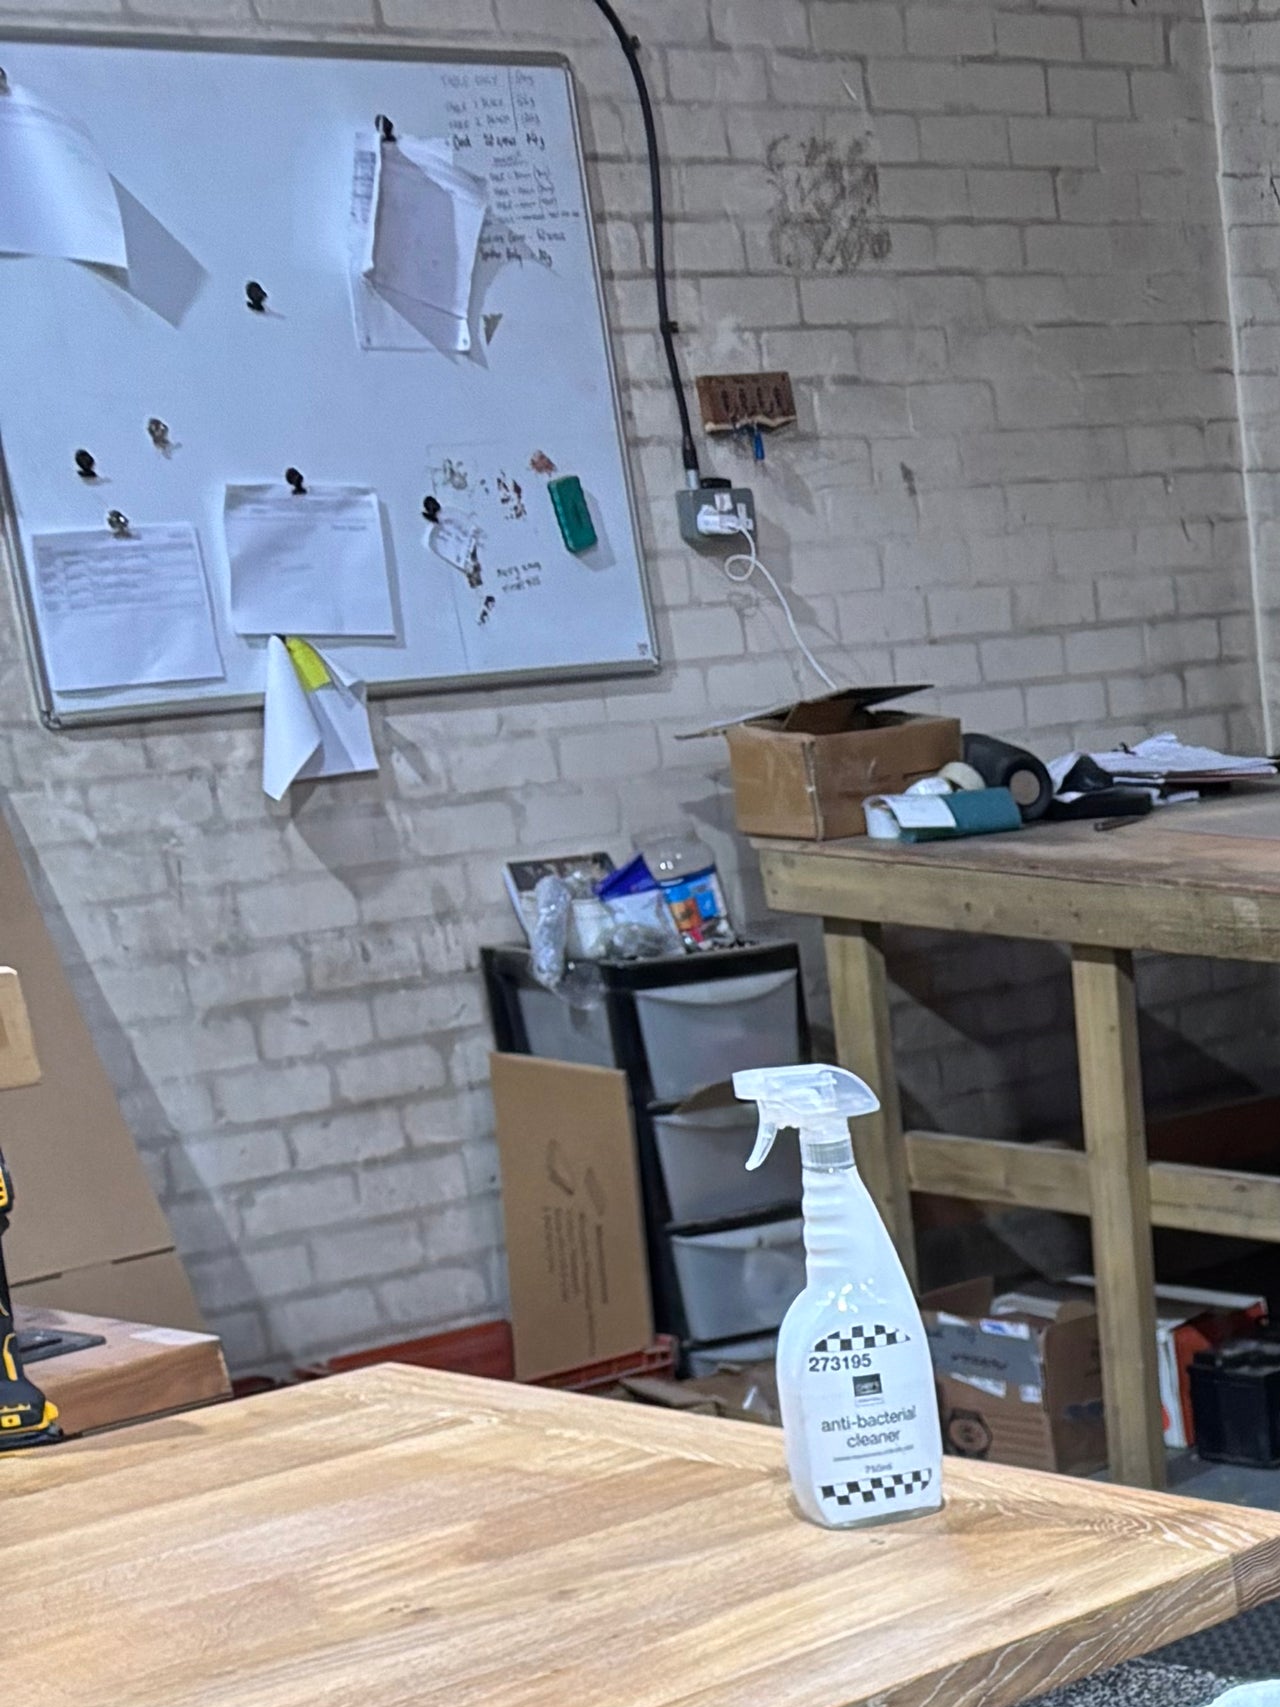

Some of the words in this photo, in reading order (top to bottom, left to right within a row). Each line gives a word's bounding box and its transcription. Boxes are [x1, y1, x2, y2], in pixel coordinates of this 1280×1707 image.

[808, 1353, 872, 1373] 273195
[821, 1405, 917, 1433] anti-bacterial
[846, 1430, 901, 1448] cleaner
